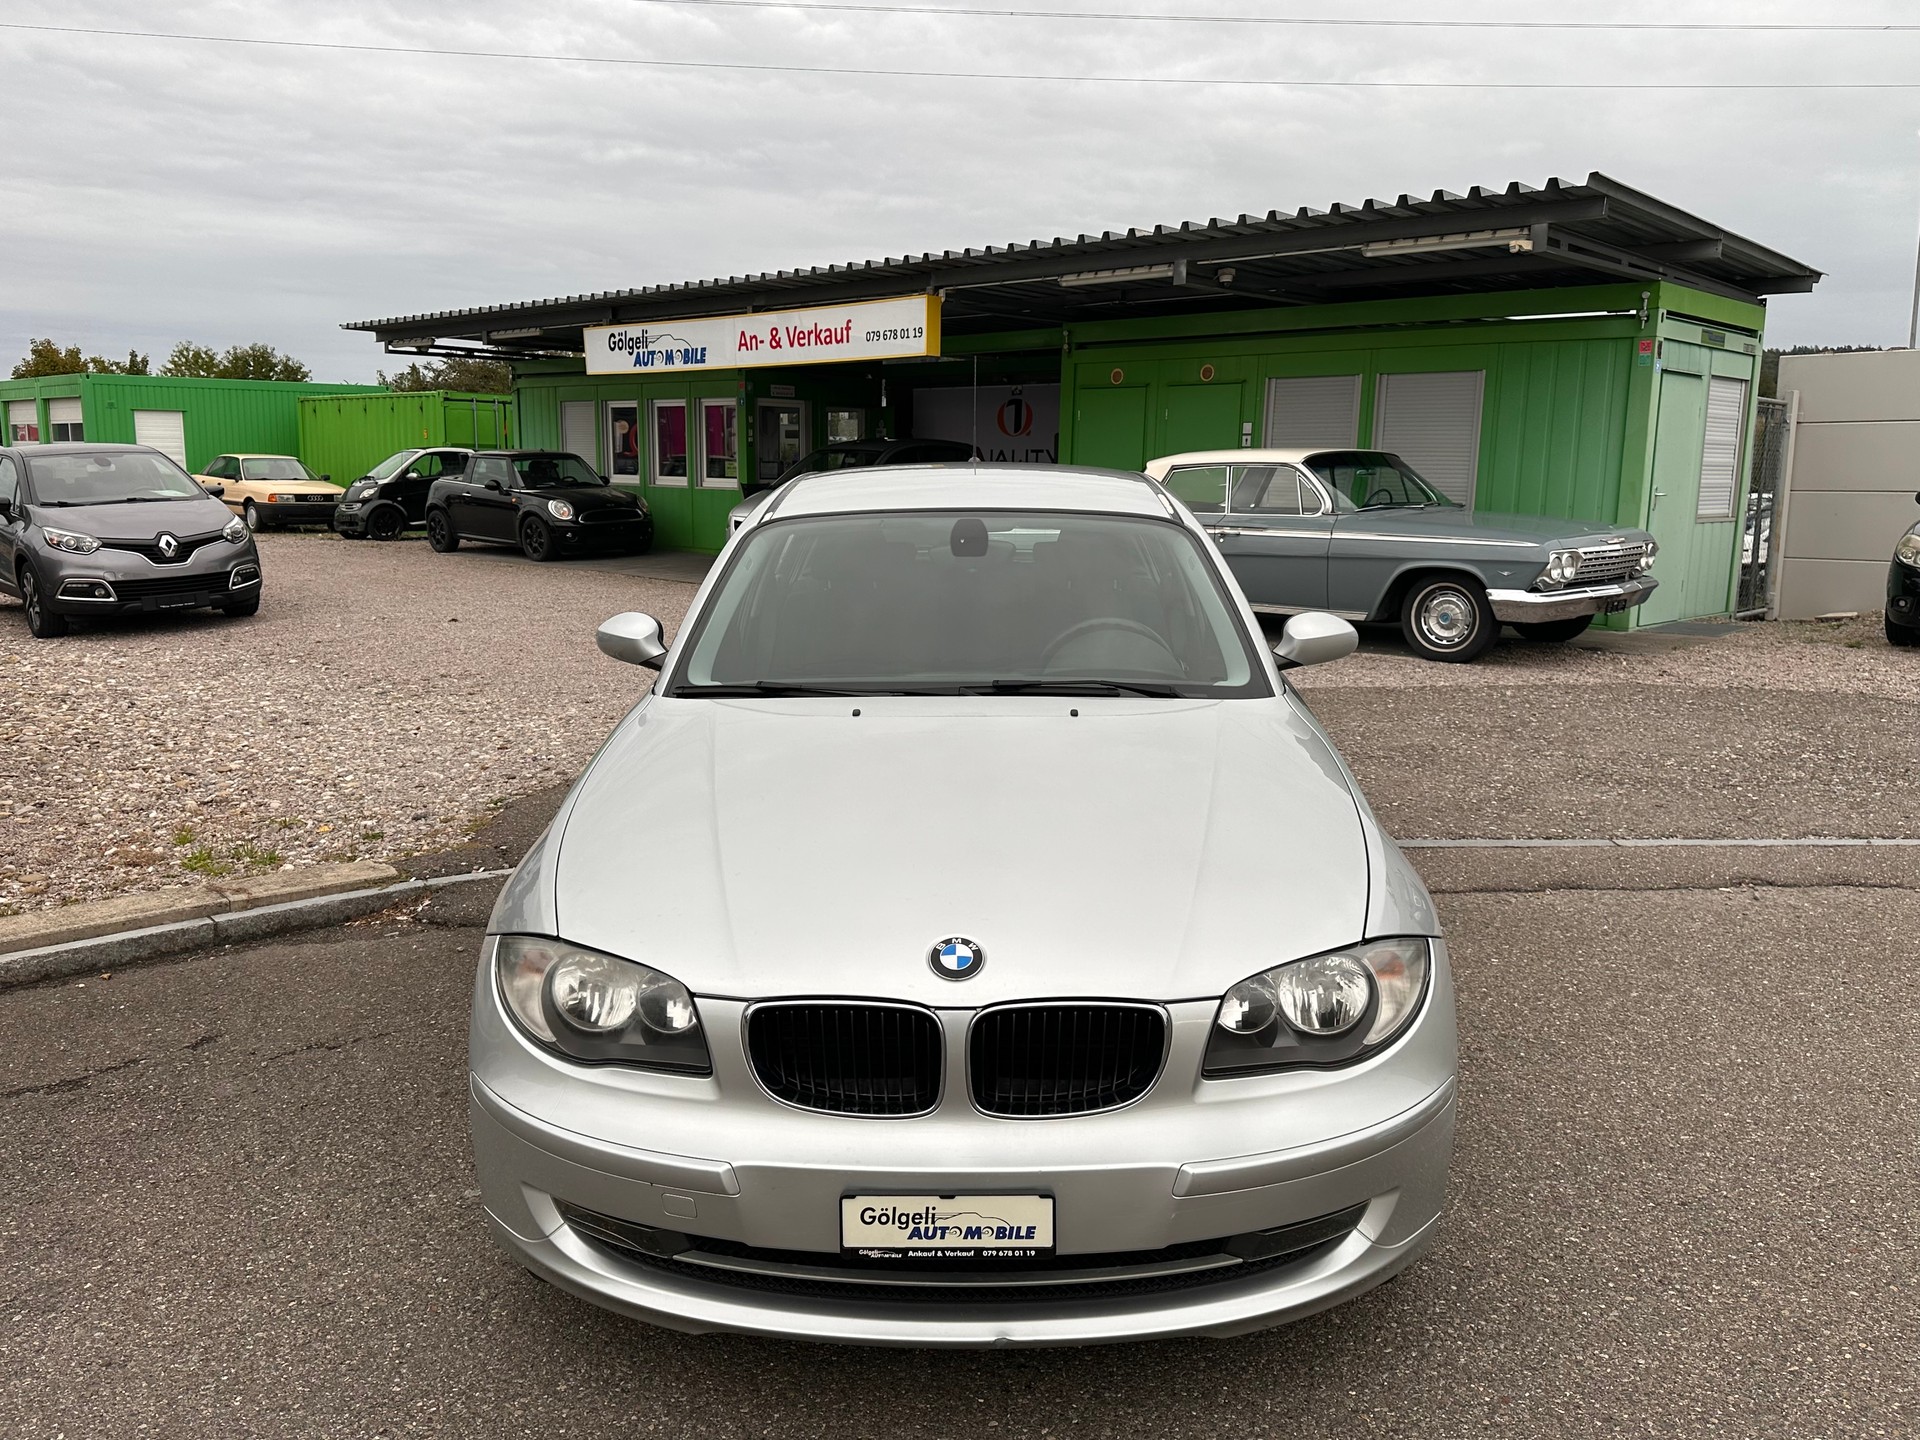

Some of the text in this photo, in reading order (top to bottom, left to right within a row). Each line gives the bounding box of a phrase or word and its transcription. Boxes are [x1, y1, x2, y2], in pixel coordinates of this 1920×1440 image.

[608, 329, 648, 355] Gölgeli
[738, 319, 852, 351] An- & Verkauf
[865, 327, 923, 342] 079 678 01 19
[633, 347, 707, 367] AUTOMOBILE
[935, 938, 979, 951] BMW
[860, 1206, 936, 1230] Gölgeli
[907, 1226, 1037, 1240] AUTOMOBILE
